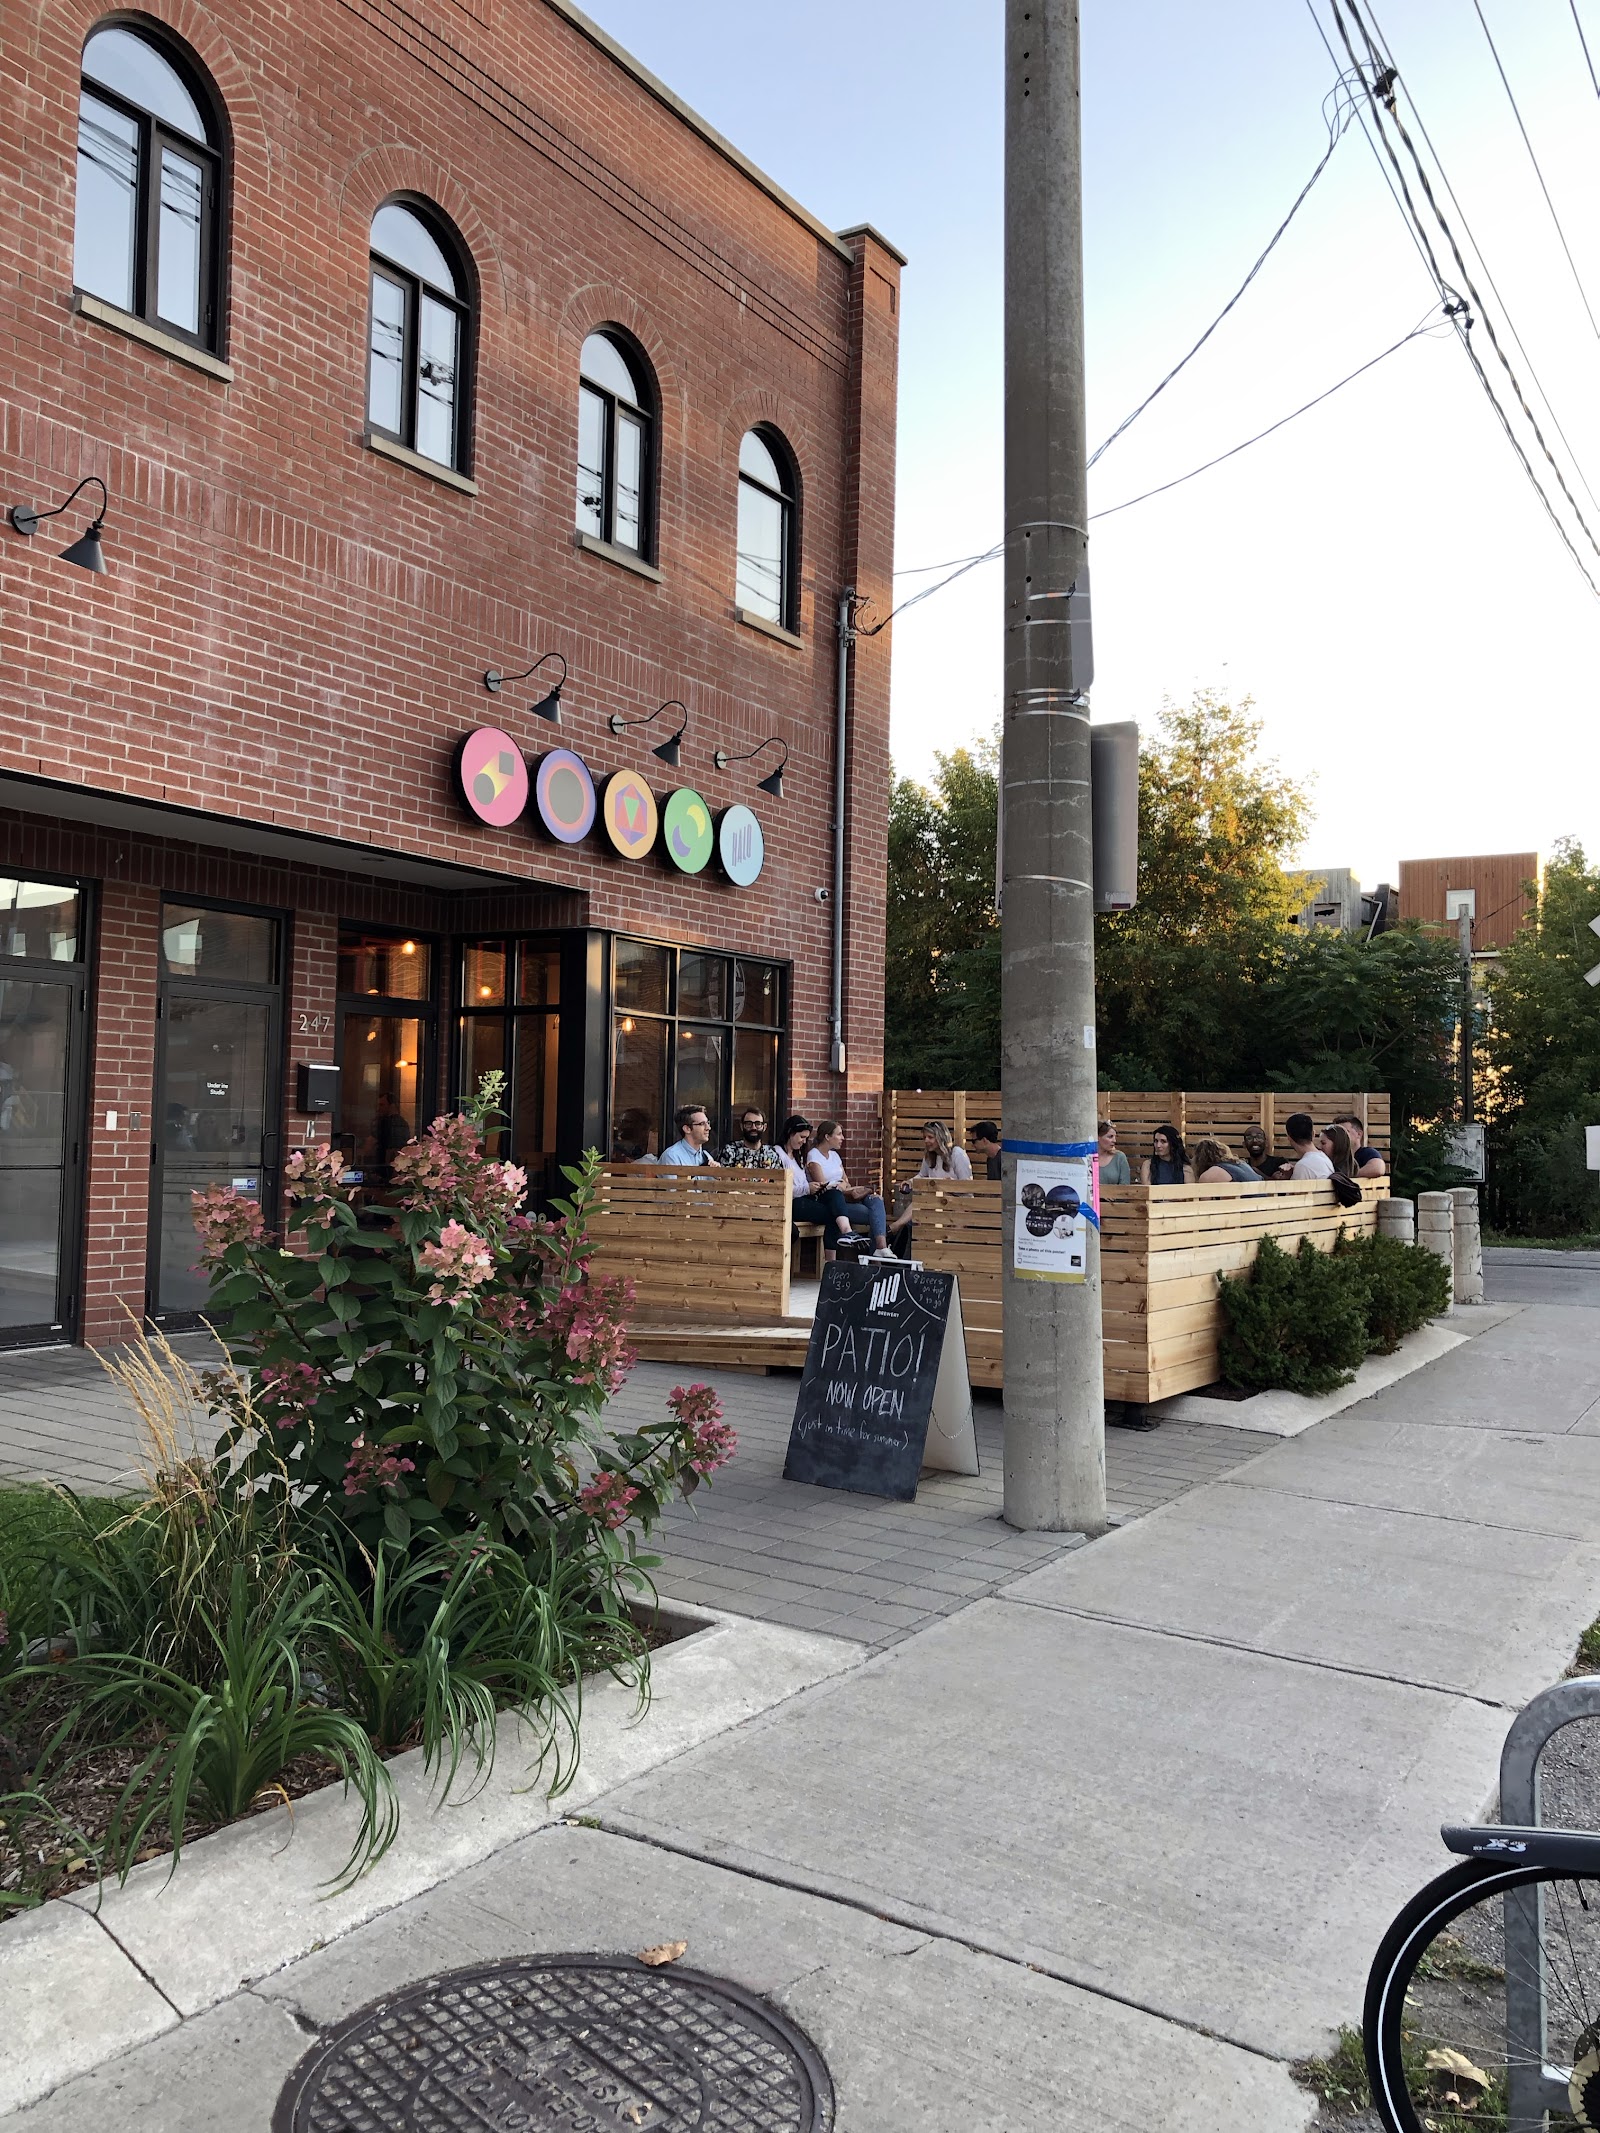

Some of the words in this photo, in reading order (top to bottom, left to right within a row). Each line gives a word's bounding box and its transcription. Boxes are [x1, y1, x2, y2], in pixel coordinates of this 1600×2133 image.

[299, 1013, 331, 1033] 247
[209, 1088, 226, 1096] Studio
[828, 1266, 850, 1285] Open
[869, 1272, 901, 1311] HALO
[878, 1310, 900, 1319] BREWERY
[820, 1322, 925, 1383] PATIO!
[825, 1379, 858, 1409] NOW
[862, 1384, 905, 1421] OPEN
[825, 1424, 833, 1434] in
[836, 1415, 856, 1438] time
[860, 1419, 872, 1441] for
